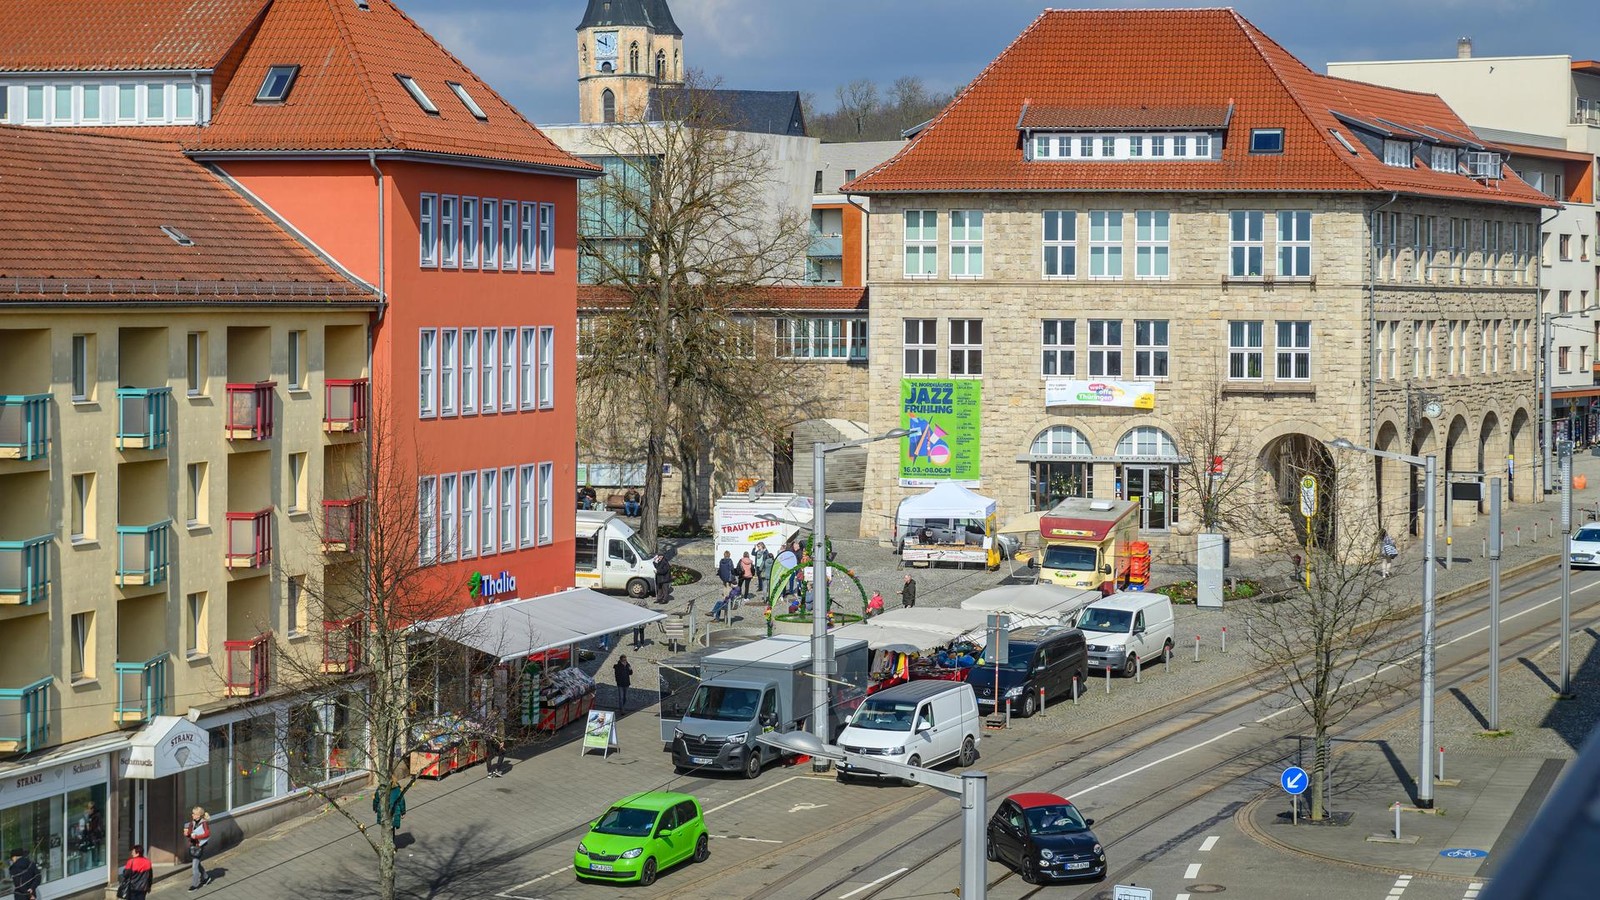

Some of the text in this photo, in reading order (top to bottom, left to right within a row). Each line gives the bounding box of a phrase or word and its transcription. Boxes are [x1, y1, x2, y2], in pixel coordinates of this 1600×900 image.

[905, 388, 953, 404] JAZZ
[481, 570, 516, 597] Thalia
[170, 734, 194, 748] STRANZ
[73, 759, 102, 775] Schmuck
[120, 757, 153, 767] Schmuck
[16, 773, 43, 788] STRANZ
